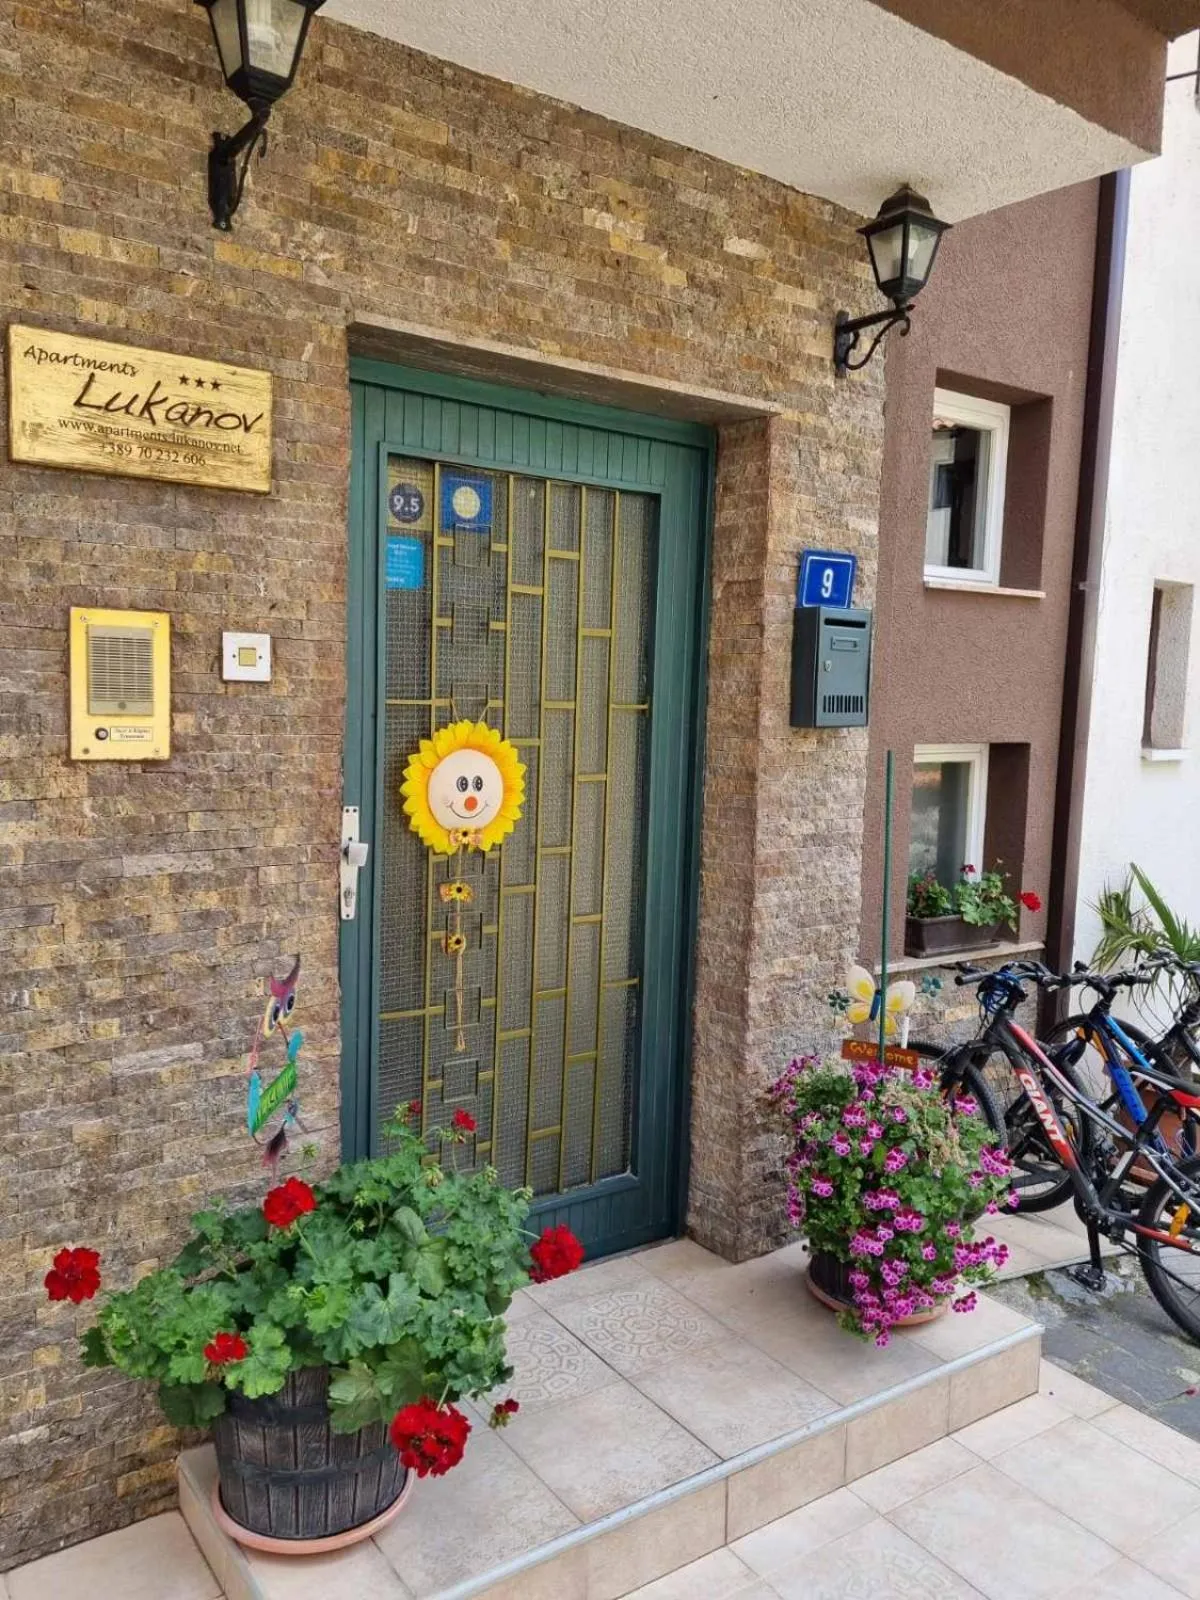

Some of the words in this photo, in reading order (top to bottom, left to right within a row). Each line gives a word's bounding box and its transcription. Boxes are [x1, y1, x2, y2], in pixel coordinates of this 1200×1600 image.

[23, 345, 139, 377] Apartments
[73, 372, 263, 433] Lukanov
[99, 441, 132, 457] +389
[137, 446, 152, 460] 70
[157, 448, 179, 464] 232
[183, 451, 206, 467] 606
[393, 494, 420, 513] 9.5
[822, 568, 834, 598] 9
[1018, 1072, 1067, 1146] GIANT
